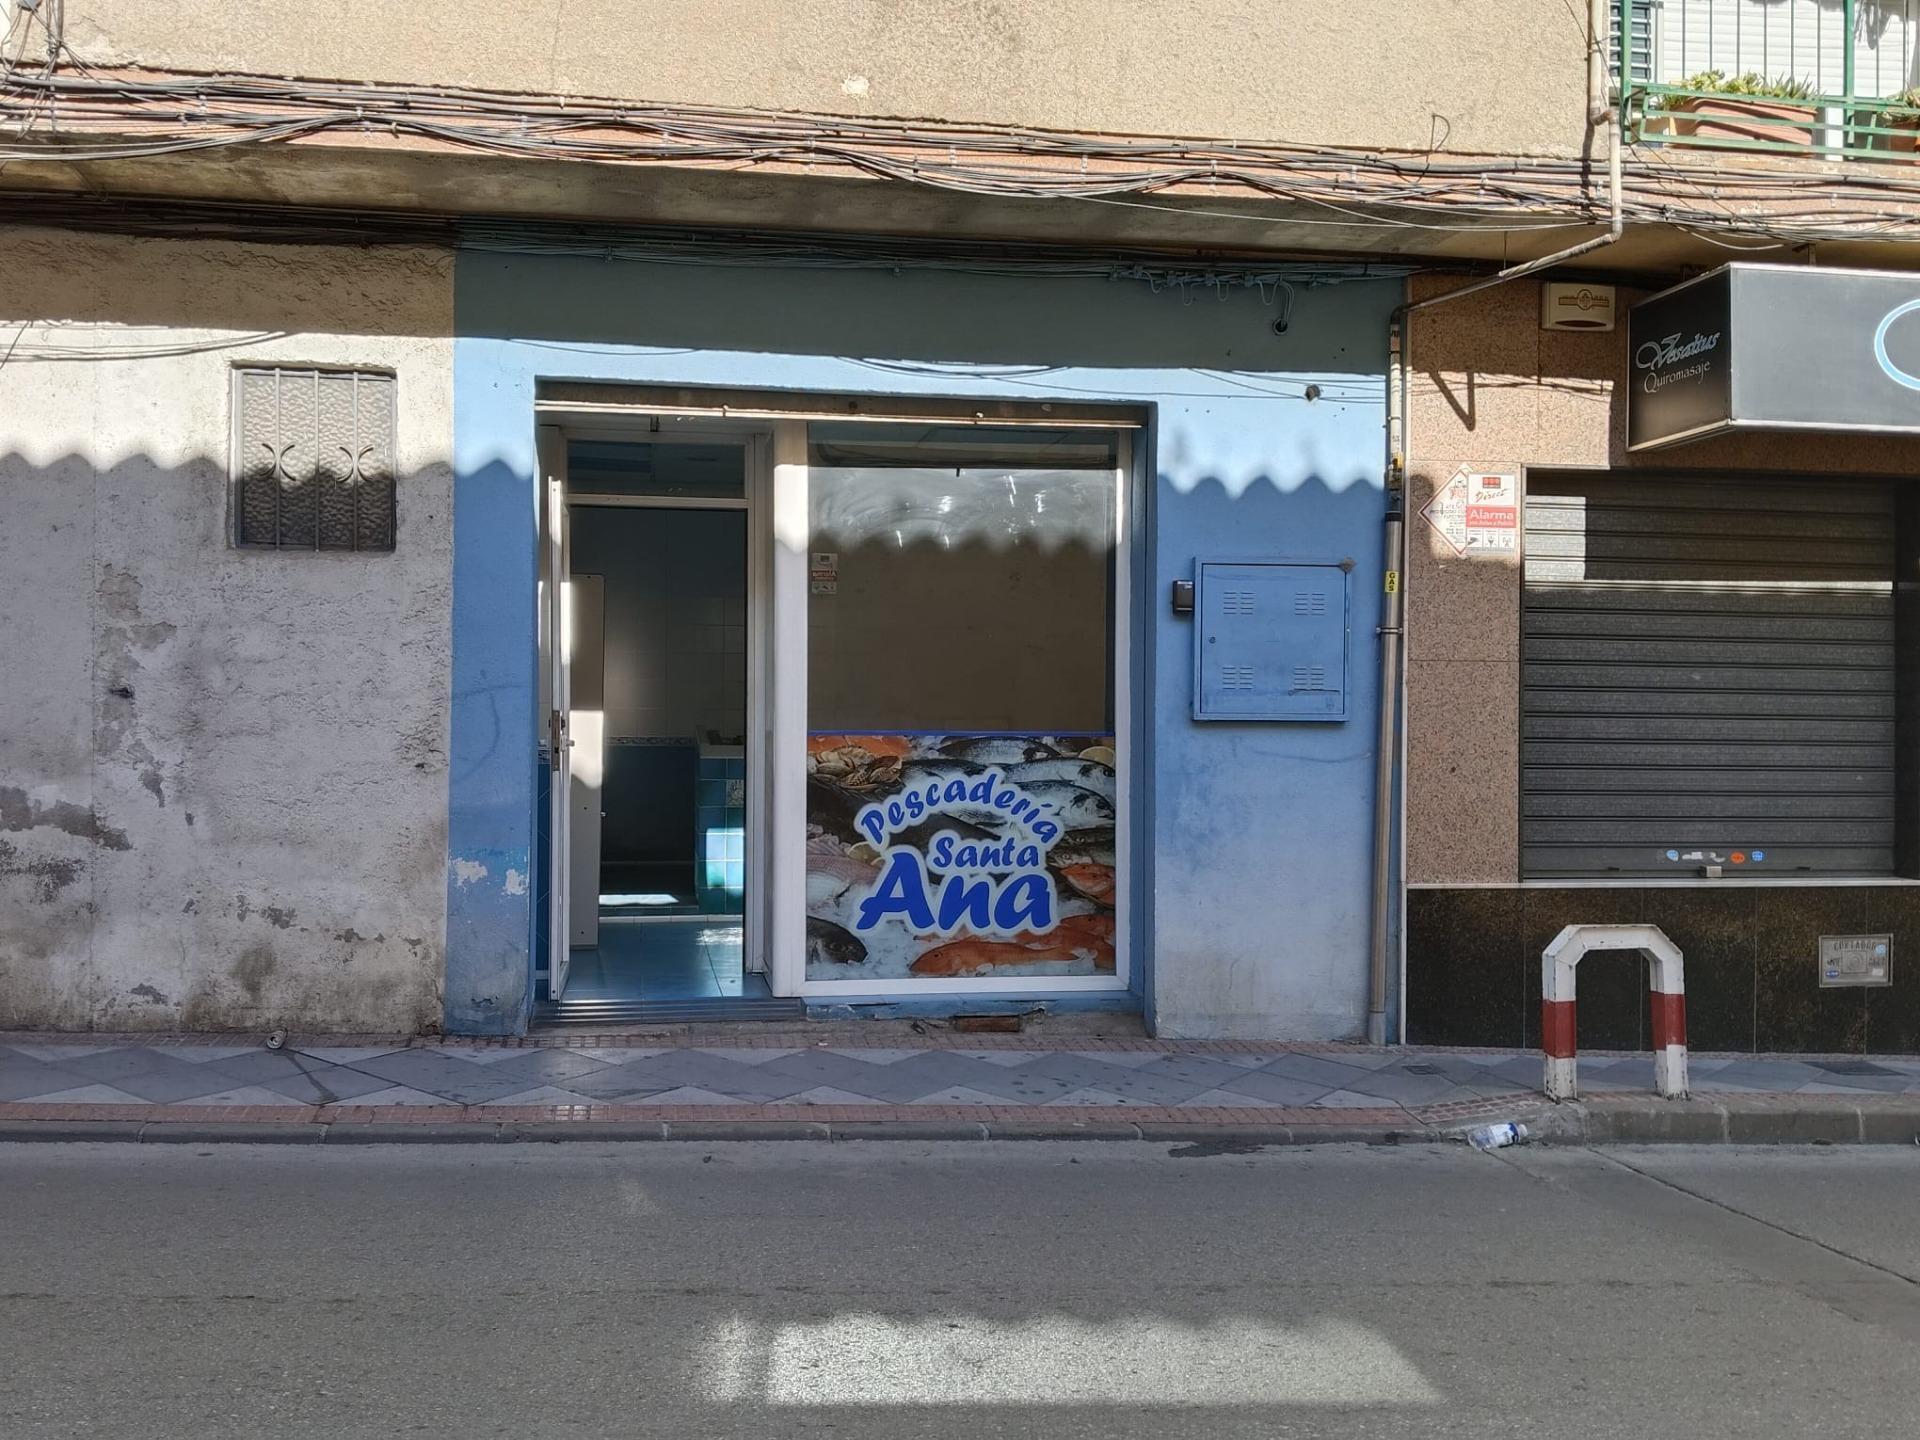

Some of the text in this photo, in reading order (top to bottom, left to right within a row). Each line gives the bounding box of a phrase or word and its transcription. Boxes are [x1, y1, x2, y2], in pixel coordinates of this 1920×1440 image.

[1644, 360, 1711, 393] Quiromasaje
[1470, 509, 1514, 520] Alarma
[1388, 572, 1396, 592] GAS
[861, 773, 1058, 844] Pescadería
[933, 836, 1039, 869] Santa
[856, 852, 1052, 931] Ana
